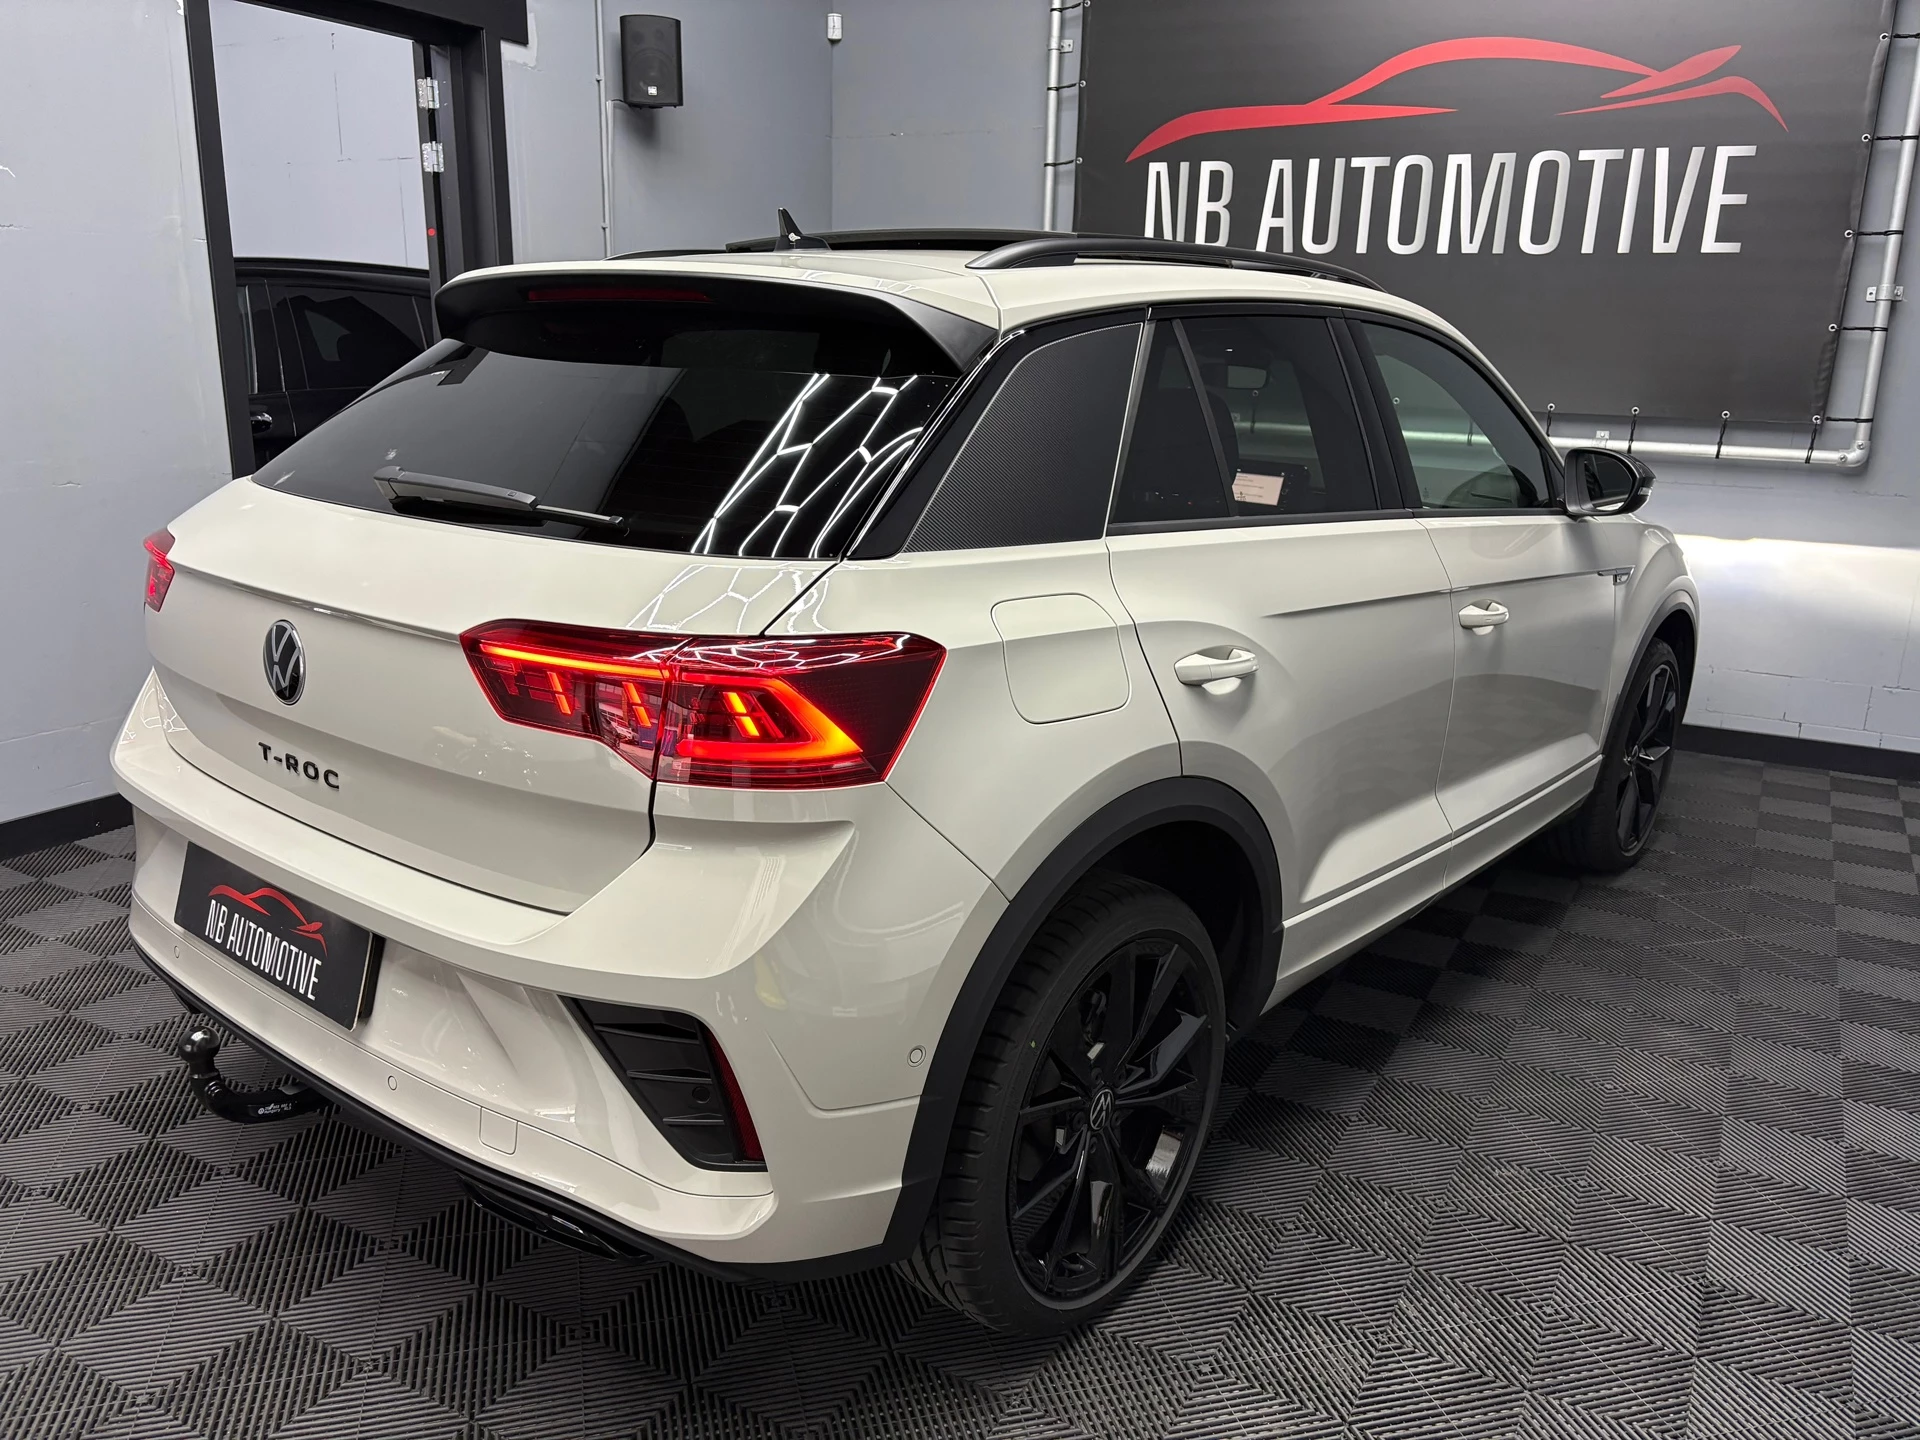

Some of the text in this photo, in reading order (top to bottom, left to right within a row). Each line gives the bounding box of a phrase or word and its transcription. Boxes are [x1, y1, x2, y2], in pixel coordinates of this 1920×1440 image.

[1145, 145, 1757, 254] NB AUTOMOTIVE
[258, 741, 340, 790] T-ROC
[205, 899, 322, 1001] NB AUTOMOTIVE
